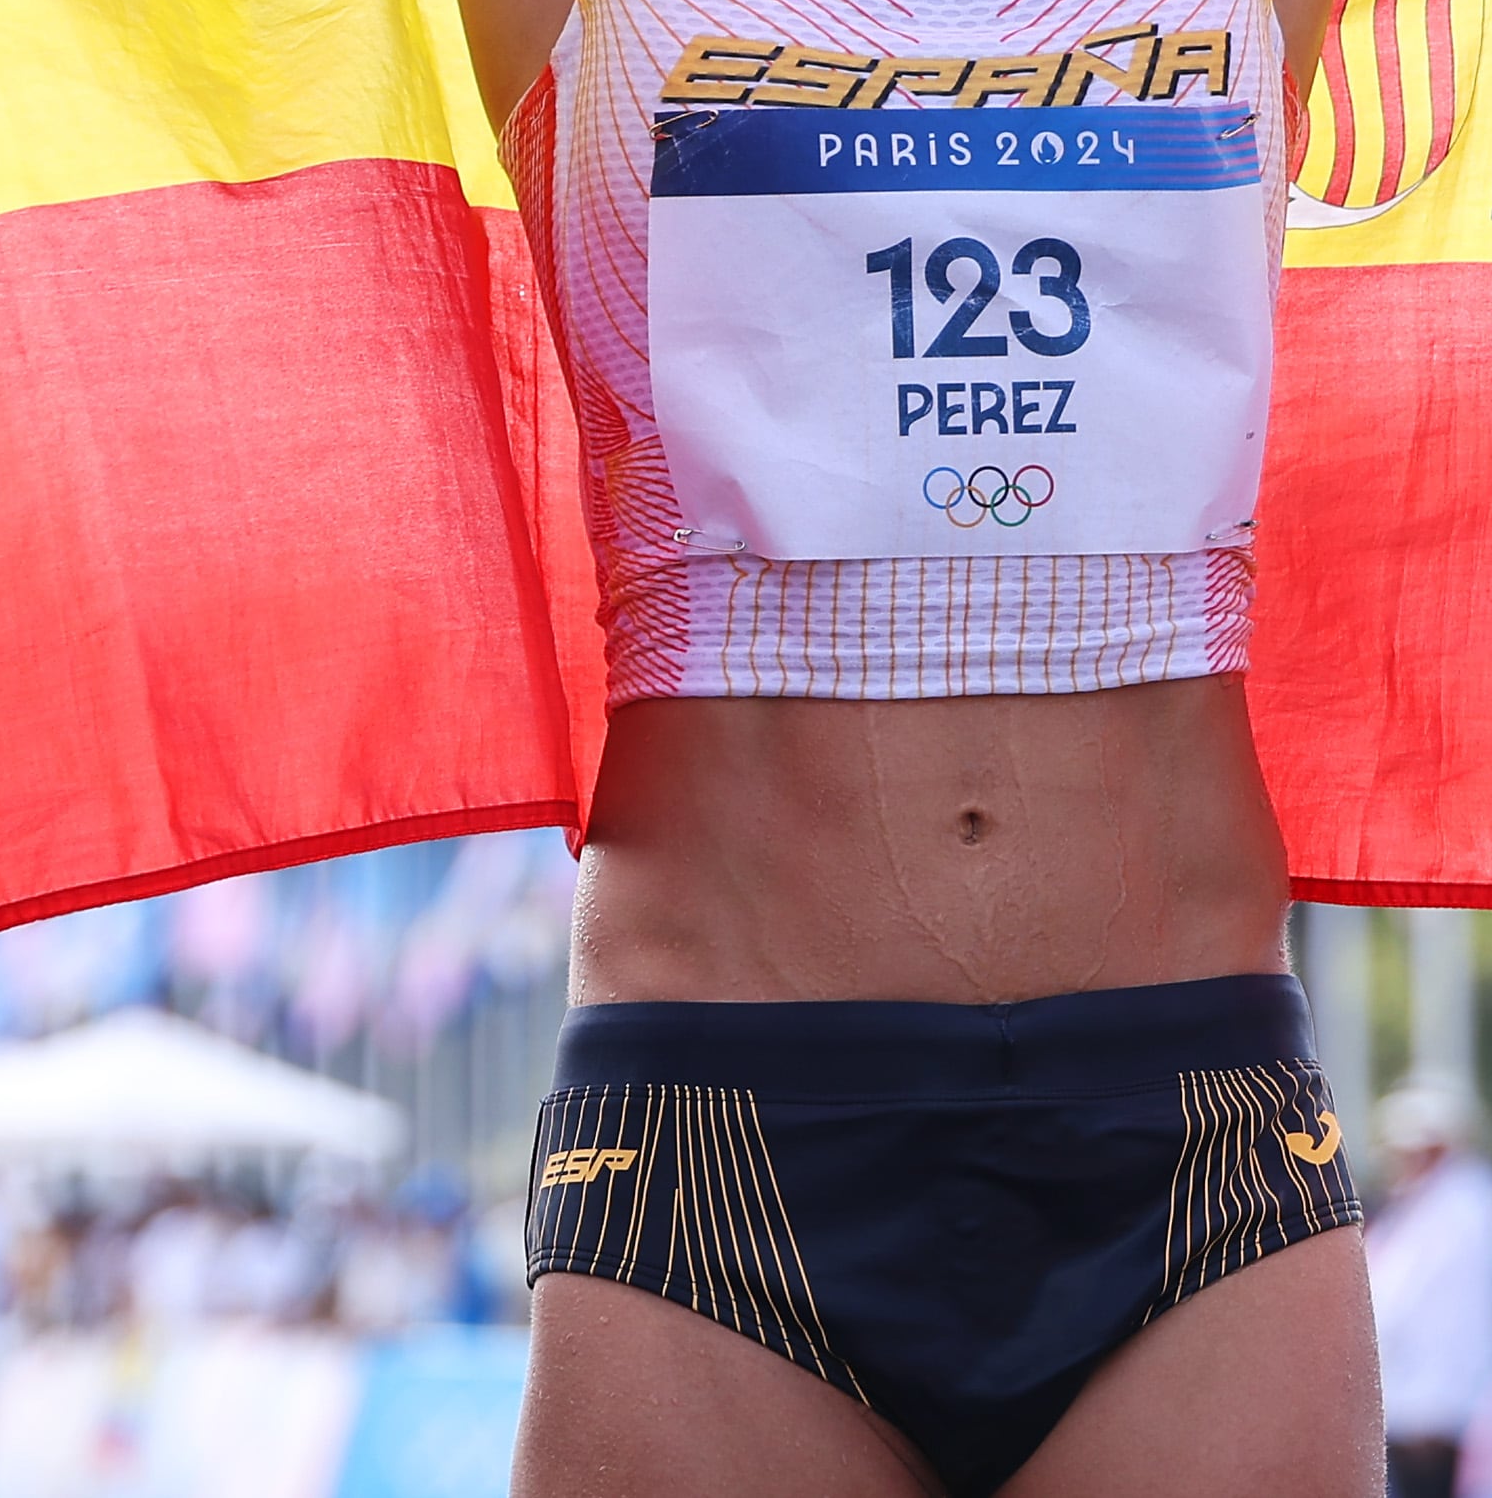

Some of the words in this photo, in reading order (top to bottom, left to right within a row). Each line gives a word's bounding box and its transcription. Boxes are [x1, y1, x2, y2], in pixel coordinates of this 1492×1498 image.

[659, 23, 1232, 110] ESPAÑA
[994, 130, 1136, 165] 2024
[864, 236, 1093, 360] 123
[896, 379, 1078, 438] PEREZ
[539, 1148, 639, 1190] ESP
